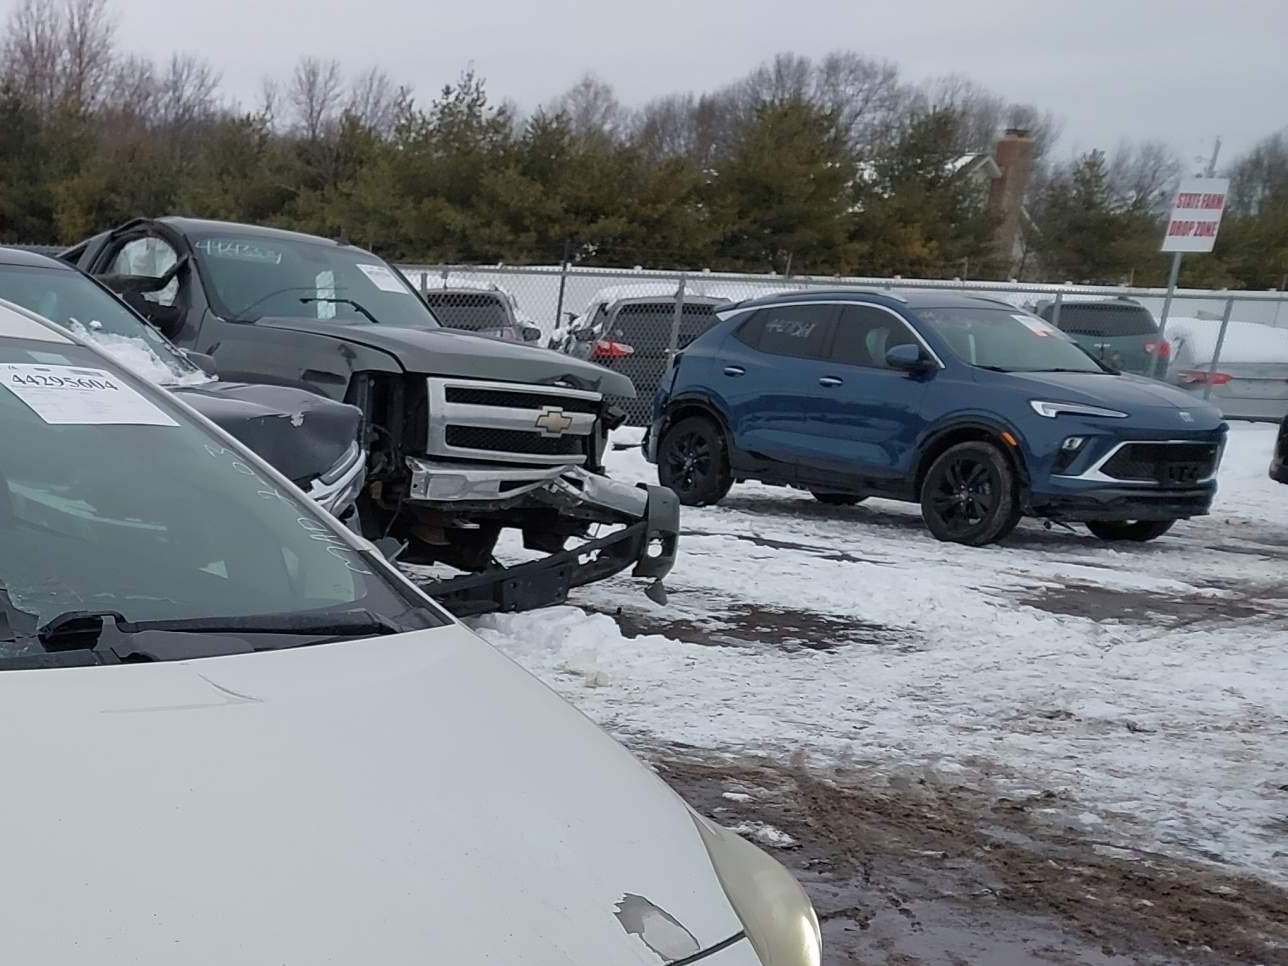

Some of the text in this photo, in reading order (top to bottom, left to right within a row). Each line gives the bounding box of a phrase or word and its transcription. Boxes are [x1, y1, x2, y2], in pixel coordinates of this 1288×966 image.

[1176, 193, 1225, 210] STATE FARM
[1169, 221, 1219, 237] DROP ZONE
[11, 373, 119, 392] 44295604
